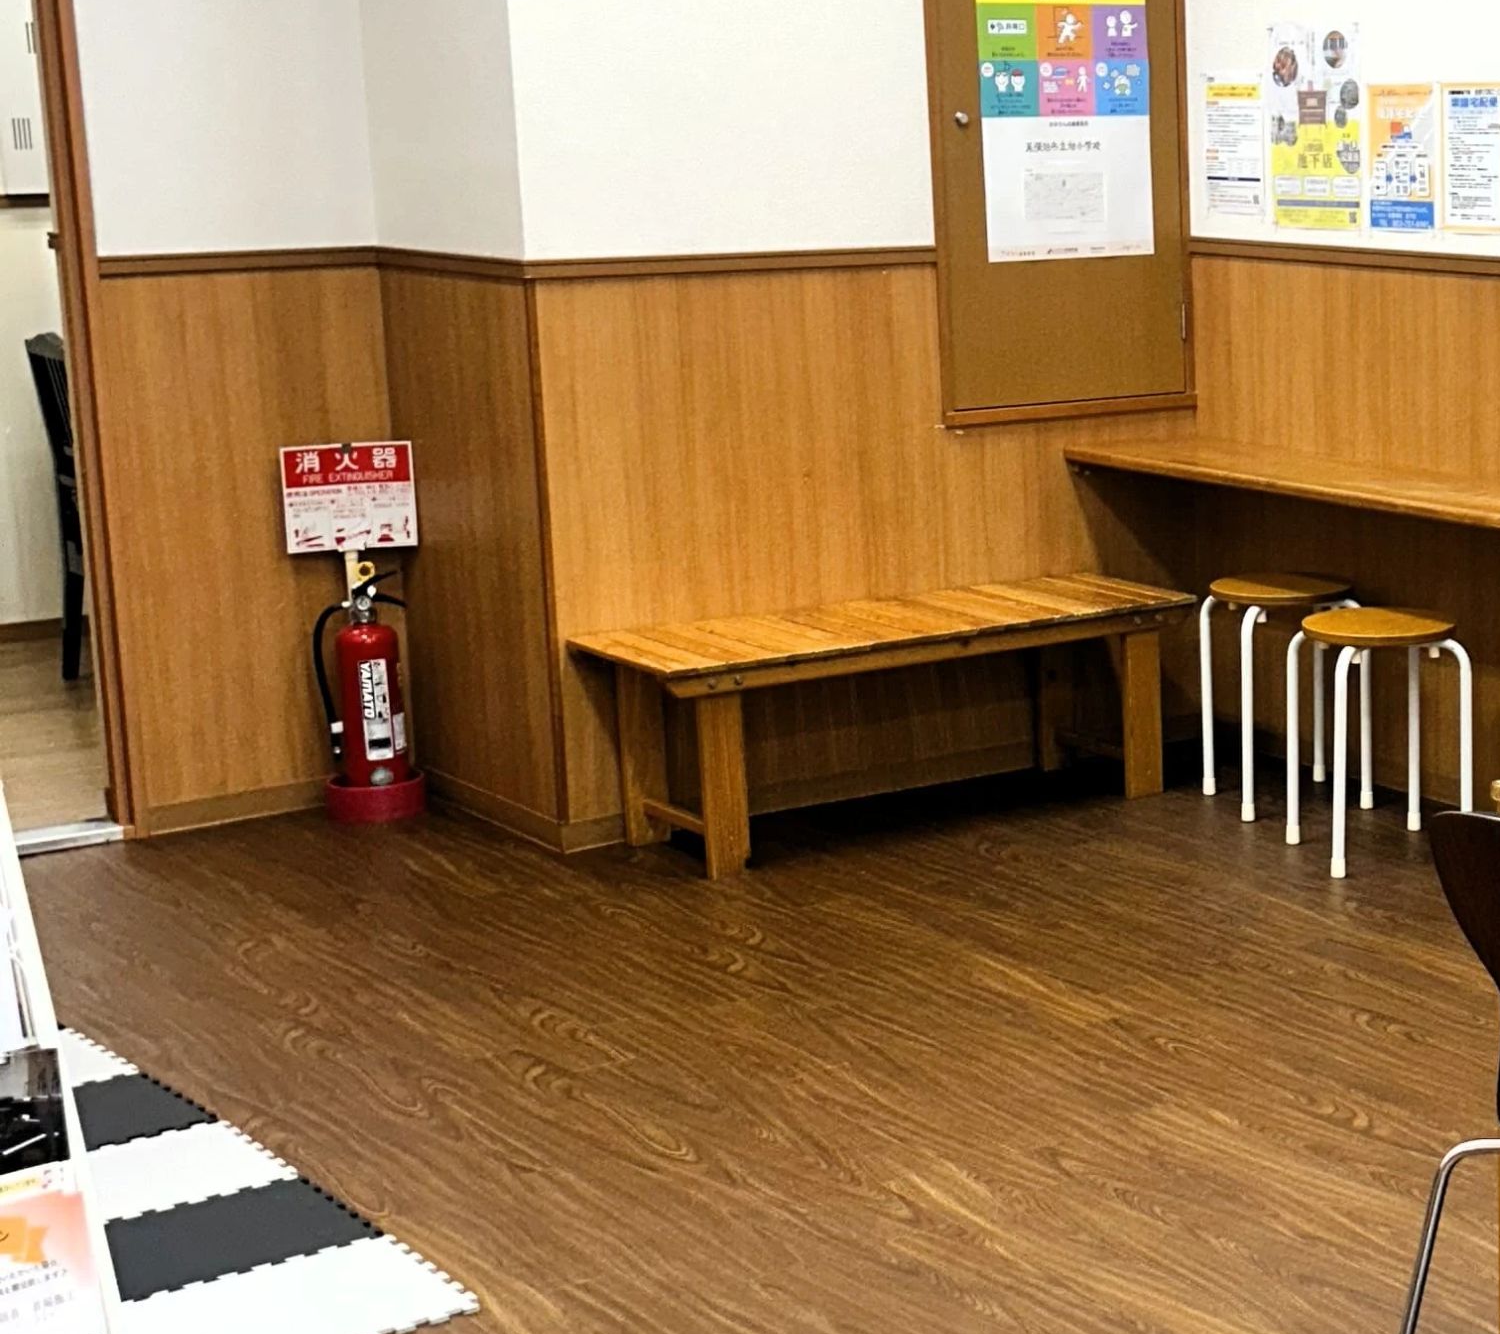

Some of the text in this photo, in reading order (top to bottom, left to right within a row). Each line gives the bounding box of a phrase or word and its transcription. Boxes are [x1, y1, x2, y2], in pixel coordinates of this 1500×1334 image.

[295, 447, 398, 474] 消火器
[302, 470, 394, 485] FIRE EXTINGUISHER
[359, 661, 375, 719] YAMATO
